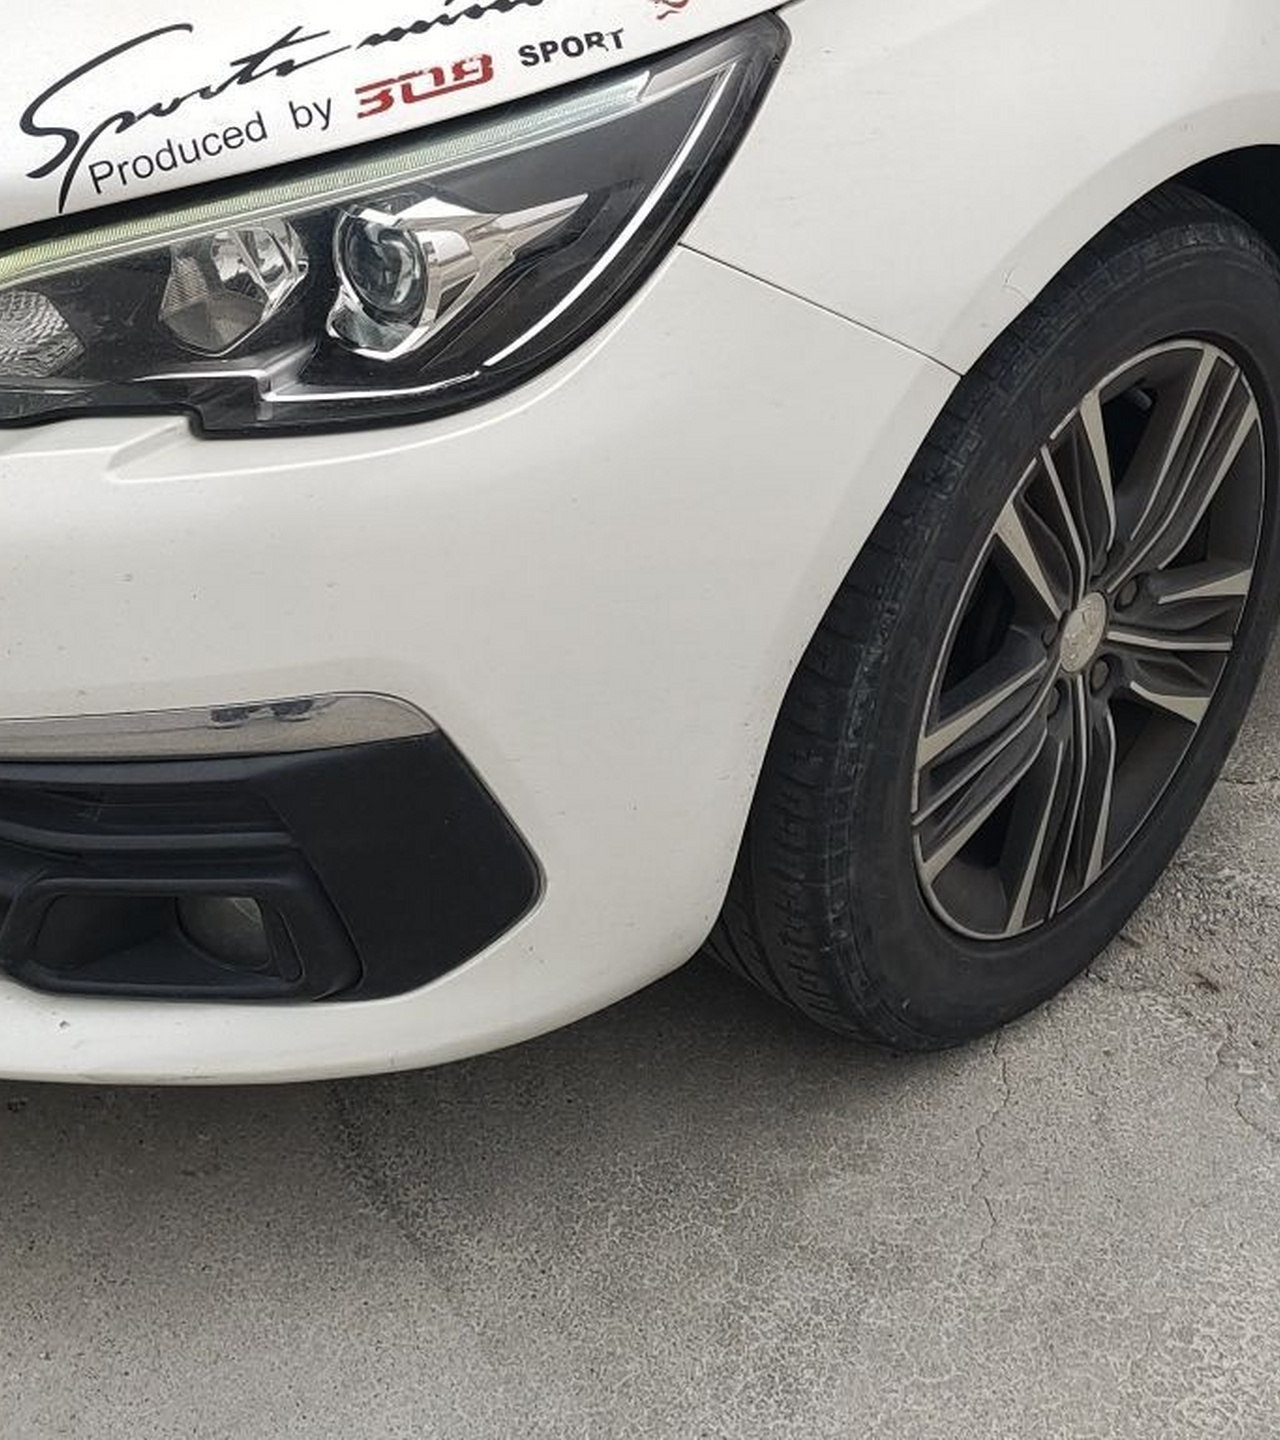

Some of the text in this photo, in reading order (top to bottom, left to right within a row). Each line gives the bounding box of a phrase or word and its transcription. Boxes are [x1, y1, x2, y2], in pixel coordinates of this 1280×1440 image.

[88, 110, 268, 194] Produced
[289, 97, 332, 130] by
[518, 28, 625, 67] SPORT
